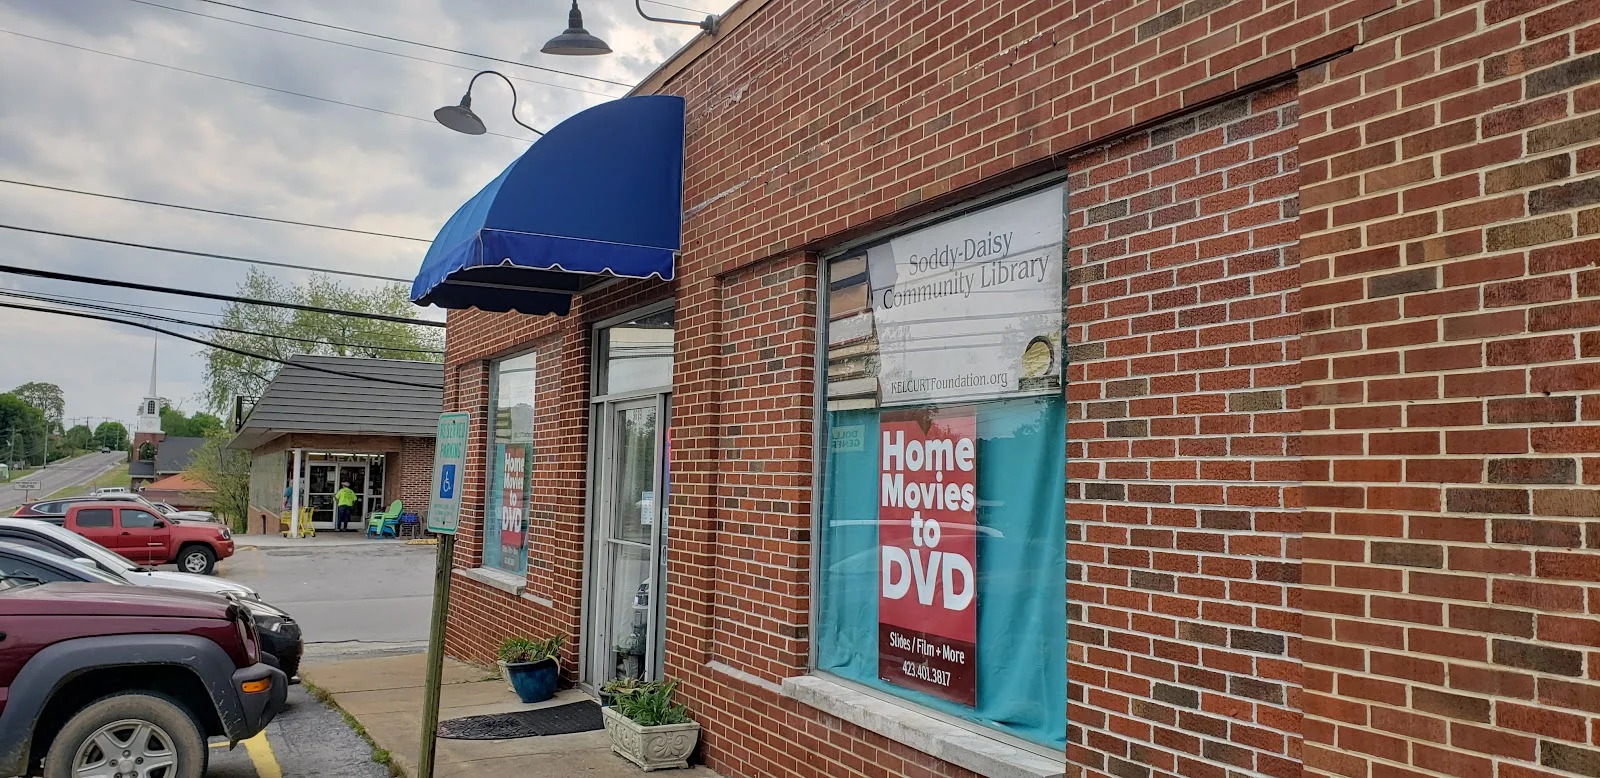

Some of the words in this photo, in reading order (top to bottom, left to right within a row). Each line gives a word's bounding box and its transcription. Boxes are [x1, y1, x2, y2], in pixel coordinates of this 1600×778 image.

[908, 231, 1014, 276] Soddy-Daisy
[883, 271, 975, 309] Community
[980, 254, 1050, 289] Library
[440, 422, 466, 439] RESERVED
[440, 442, 461, 459] PARKING
[504, 452, 525, 473] Home
[883, 430, 975, 473] Home
[503, 472, 524, 490] Movies
[881, 471, 975, 512] Movies
[509, 489, 517, 507] to
[501, 505, 522, 533] DVD
[910, 510, 941, 548] to
[881, 545, 975, 612] DVD
[889, 631, 911, 651] Slides
[916, 638, 935, 657] Film
[942, 644, 965, 665] More
[902, 660, 951, 687] 423.401.3817
